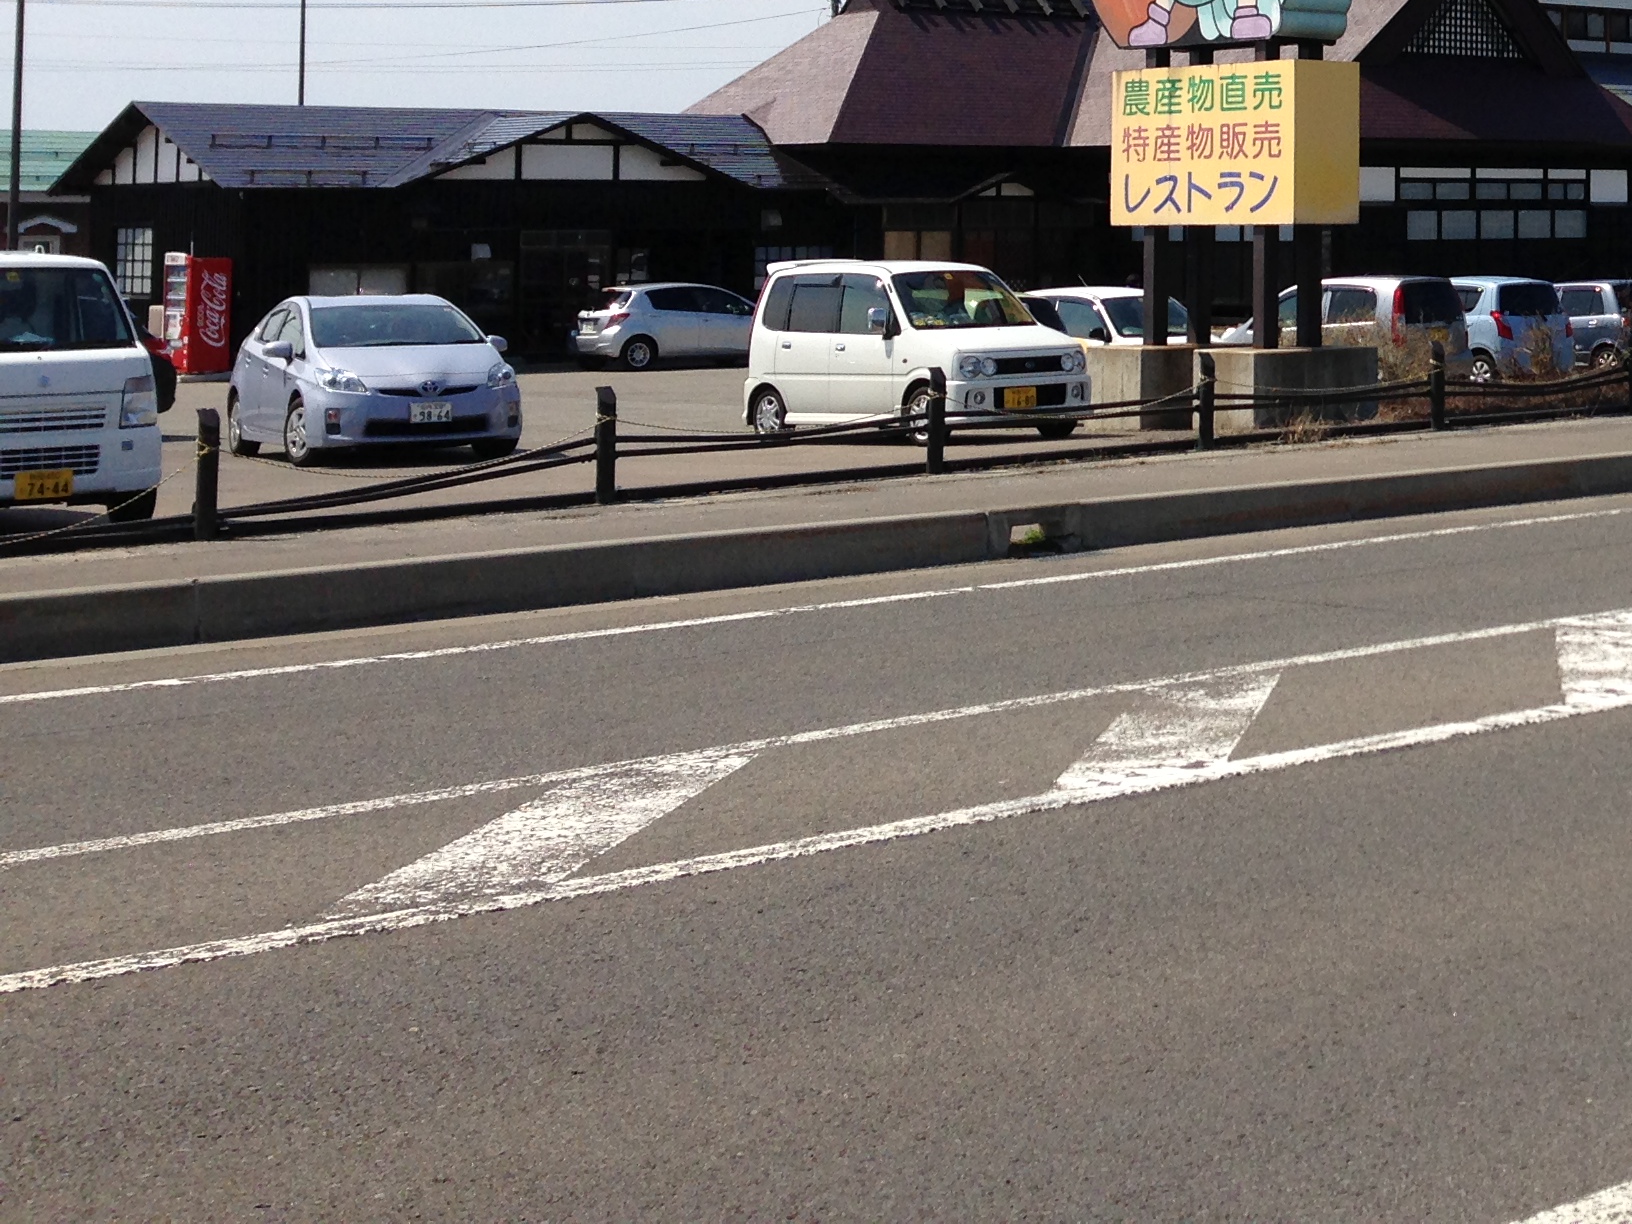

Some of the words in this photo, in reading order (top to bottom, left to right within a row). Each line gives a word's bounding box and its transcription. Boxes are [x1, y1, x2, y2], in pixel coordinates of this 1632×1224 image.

[1121, 70, 1284, 118] 農産物直売
[1121, 120, 1283, 164] 特産物販売
[1123, 170, 1279, 214] レストラン
